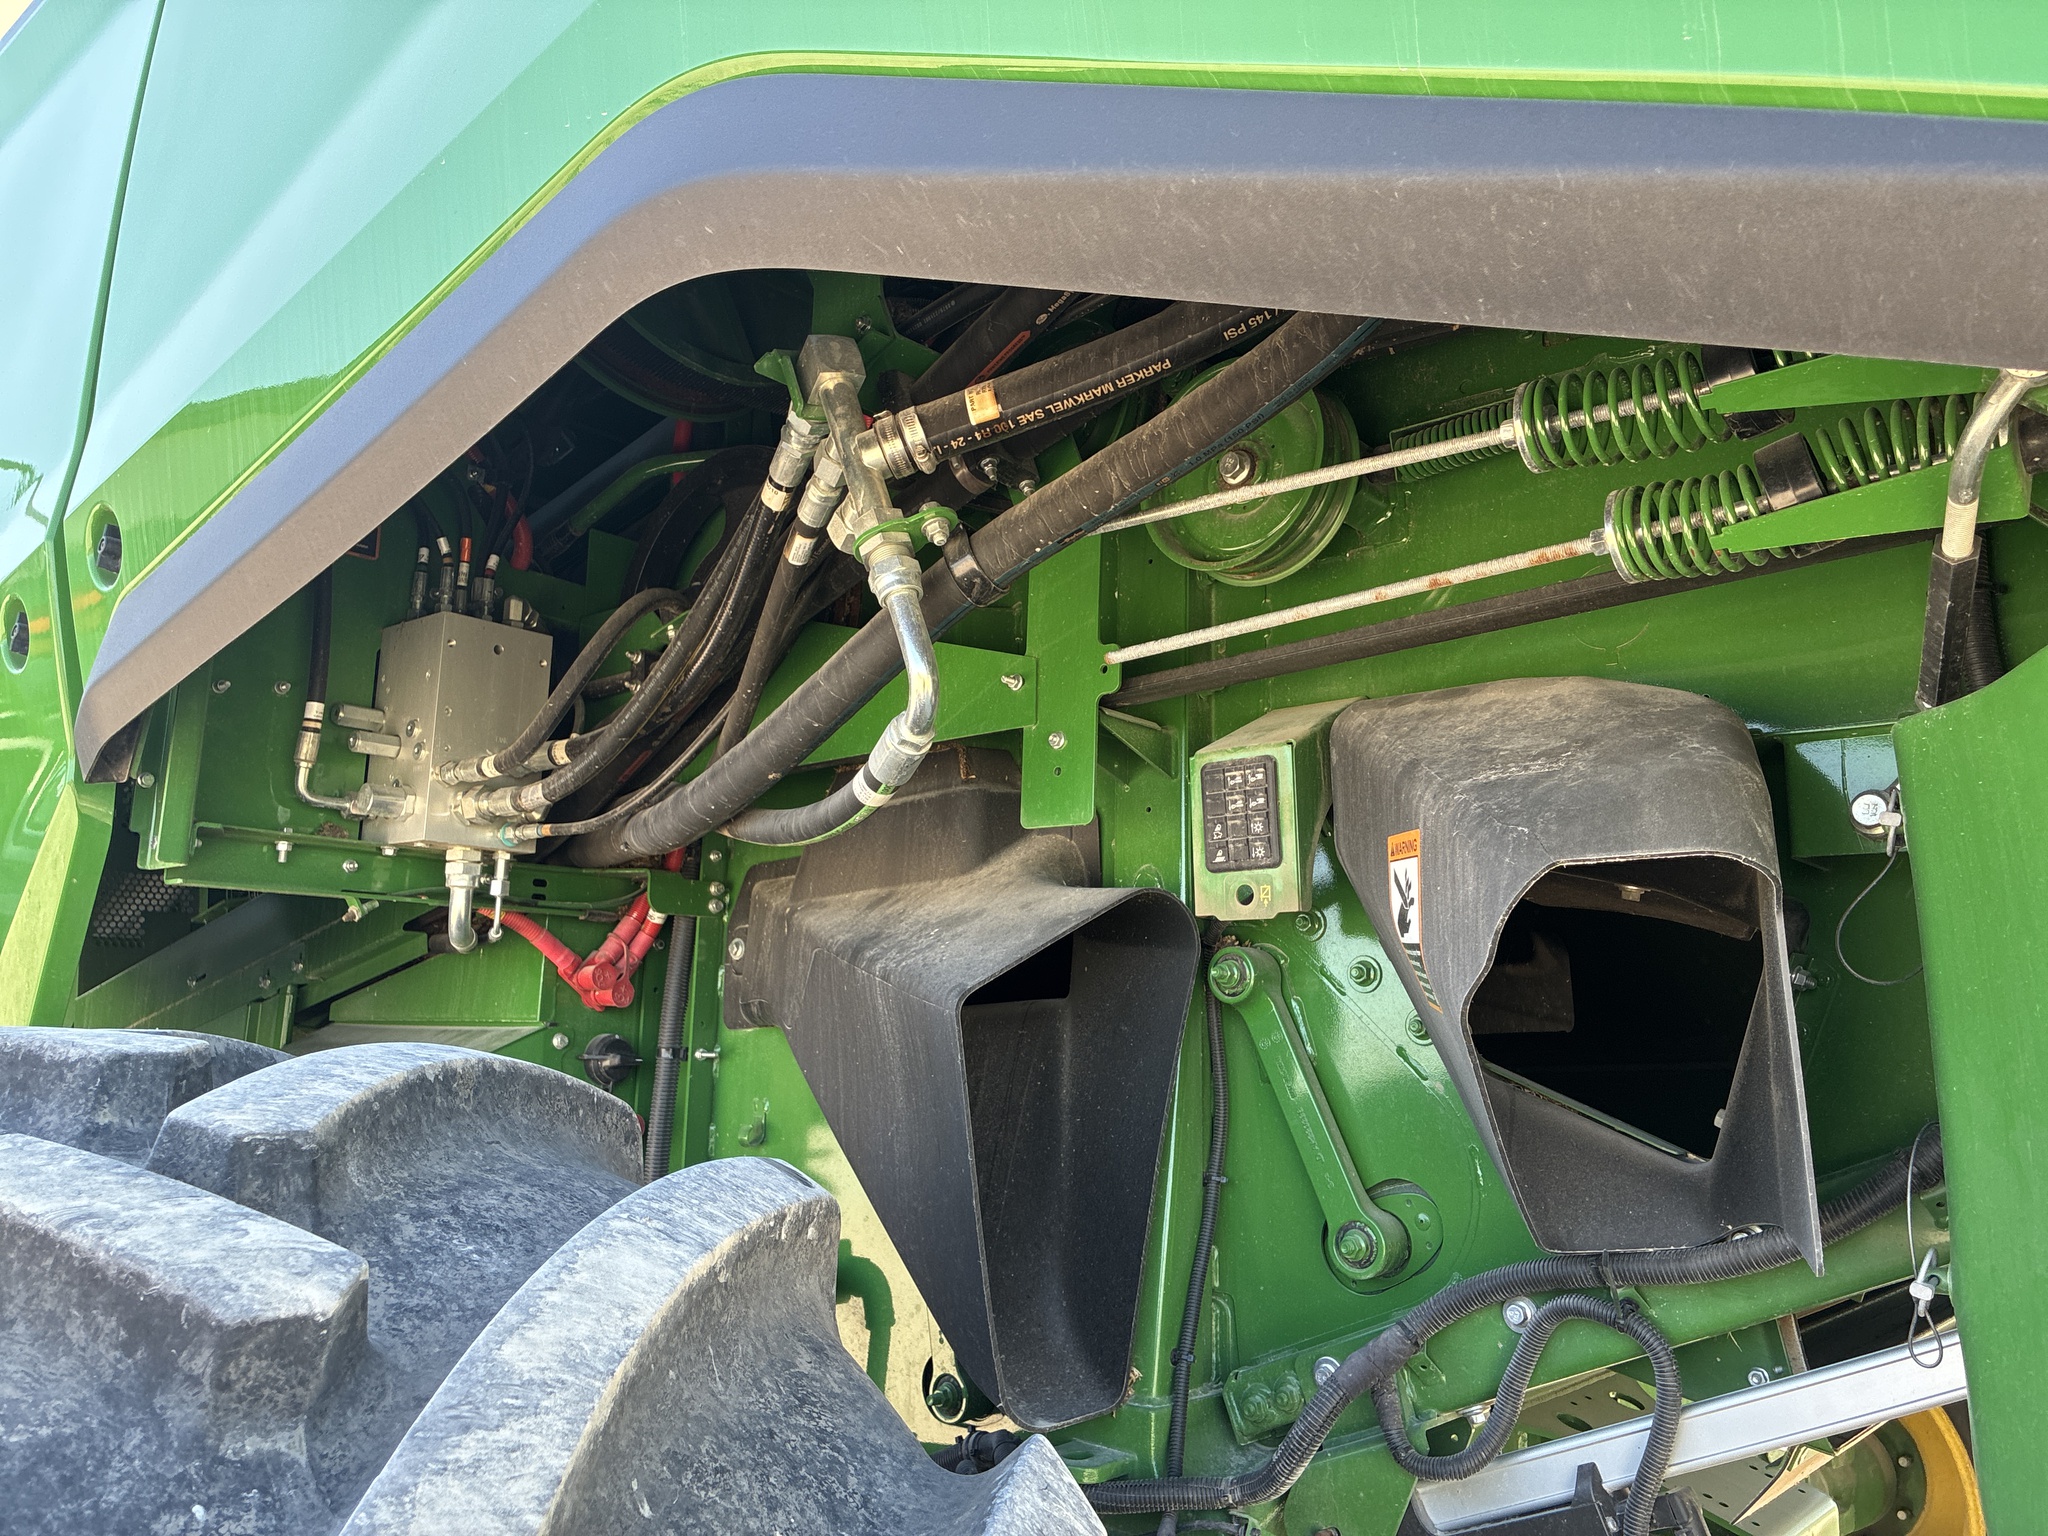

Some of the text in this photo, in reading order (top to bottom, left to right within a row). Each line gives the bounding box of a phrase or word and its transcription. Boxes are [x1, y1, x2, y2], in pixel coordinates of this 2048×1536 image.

[1048, 291, 1073, 312] MegaS
[1223, 310, 1272, 341] 145 PSI
[1116, 358, 1172, 389] PARKER
[1045, 385, 1114, 414] MARKWEL
[1016, 409, 1045, 427] SAE
[951, 436, 966, 450] 24
[1188, 413, 1265, 466] 1.0 MPa (150 PSI)
[1394, 839, 1417, 856] WARNING
